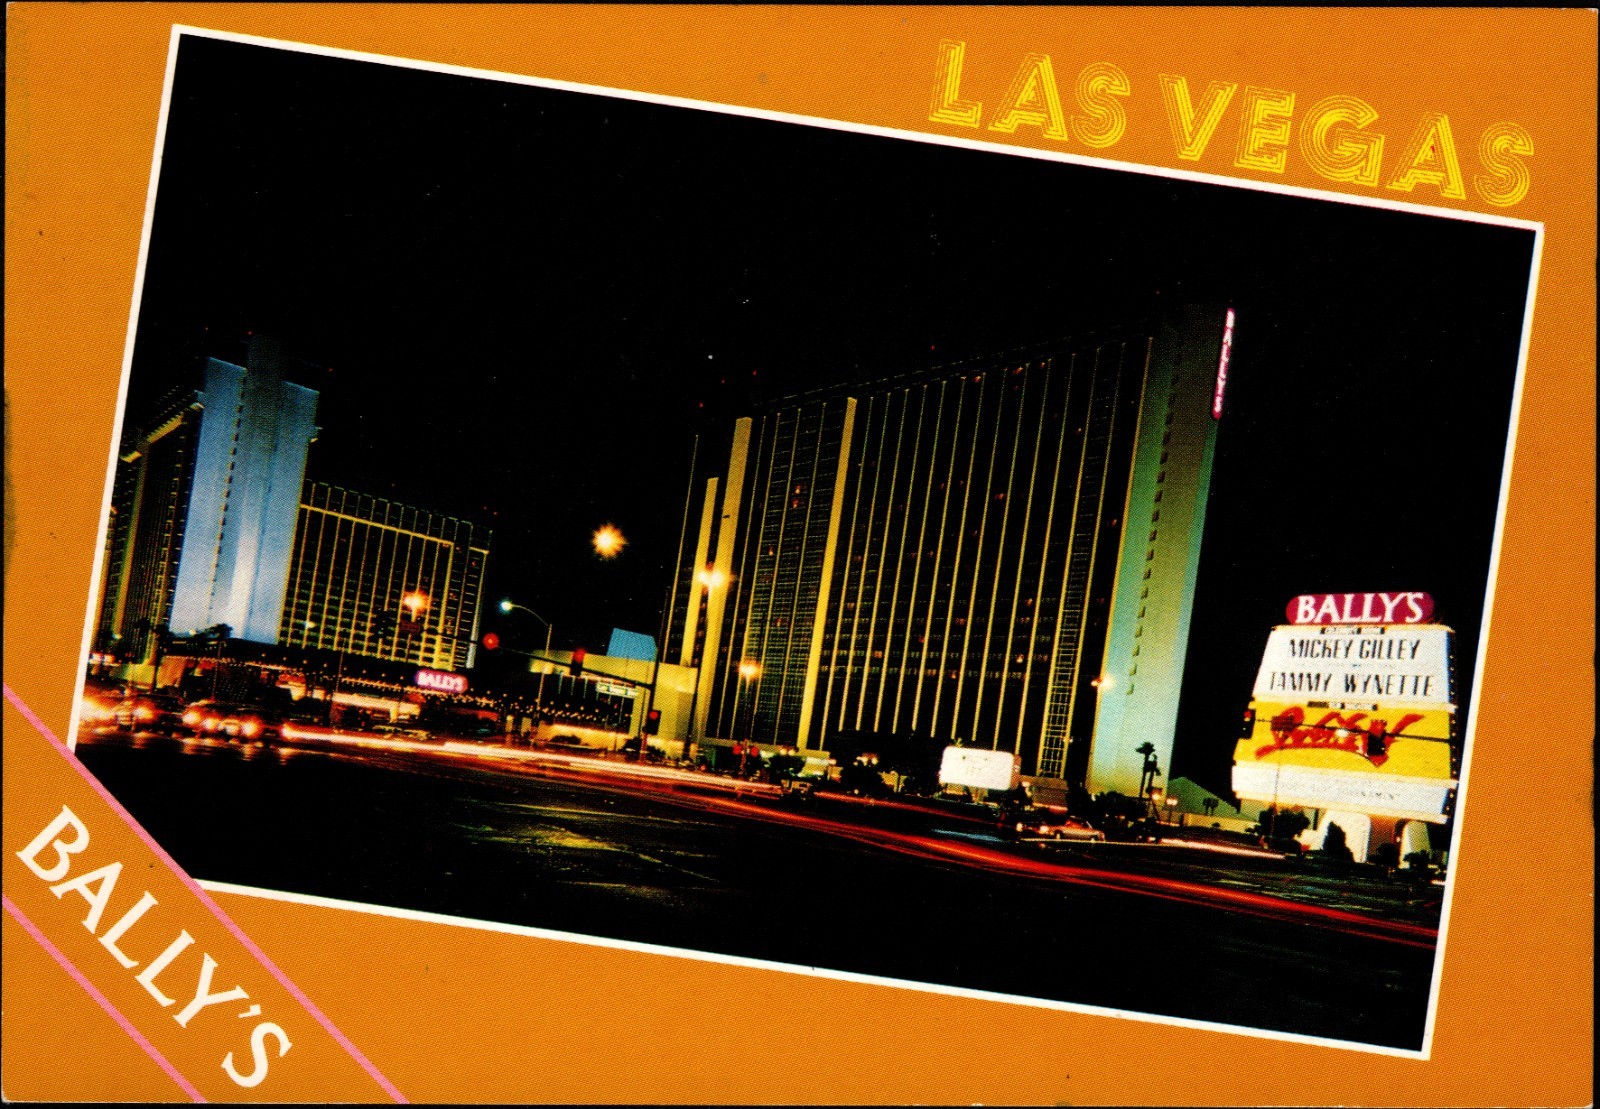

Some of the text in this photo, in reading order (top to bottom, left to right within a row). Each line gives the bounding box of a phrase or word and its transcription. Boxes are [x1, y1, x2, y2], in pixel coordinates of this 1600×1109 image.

[1289, 639, 1420, 660] MICKEY GILLEY
[1270, 672, 1434, 697] TAMMY WYNETTE
